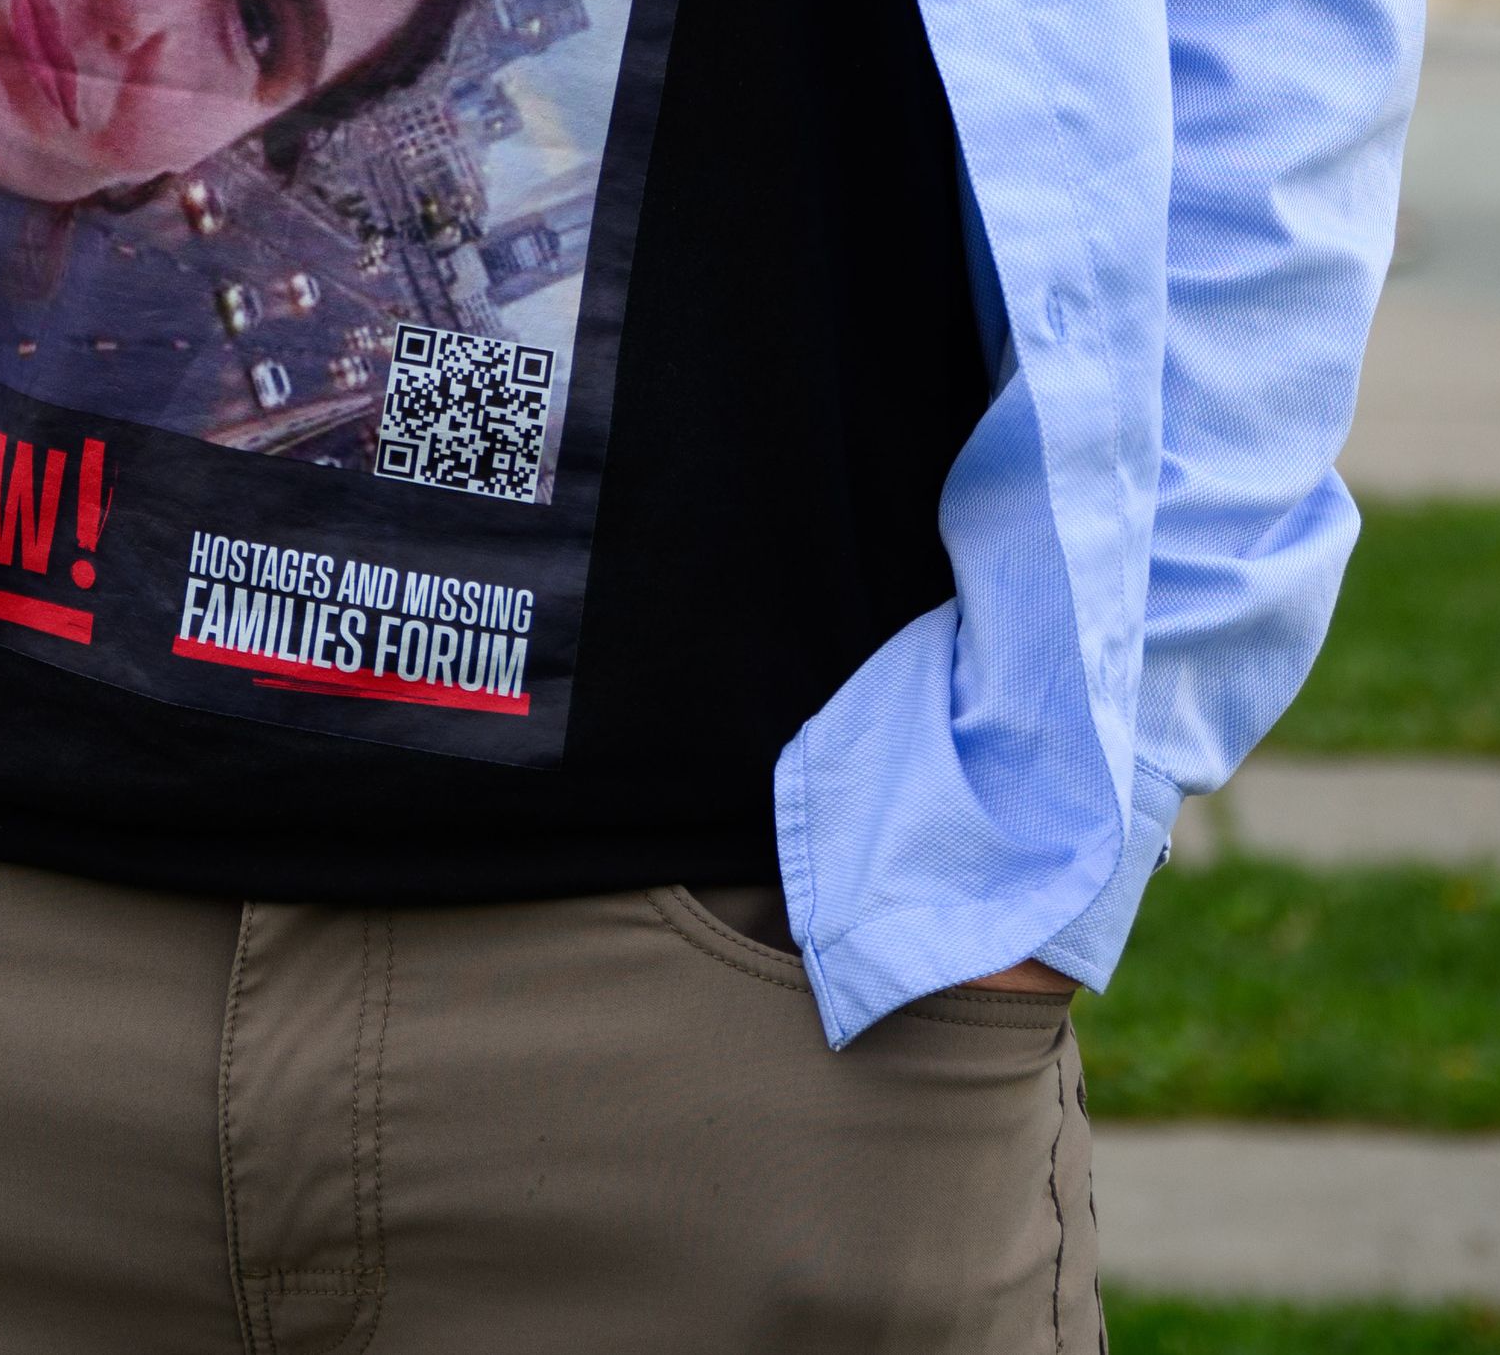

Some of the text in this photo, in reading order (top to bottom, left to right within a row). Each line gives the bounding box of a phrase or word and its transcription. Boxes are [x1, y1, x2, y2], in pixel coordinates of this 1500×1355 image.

[179, 577, 529, 699] FAMILIES FORUM
[188, 530, 534, 634] HOSTAGES AND MISSING
